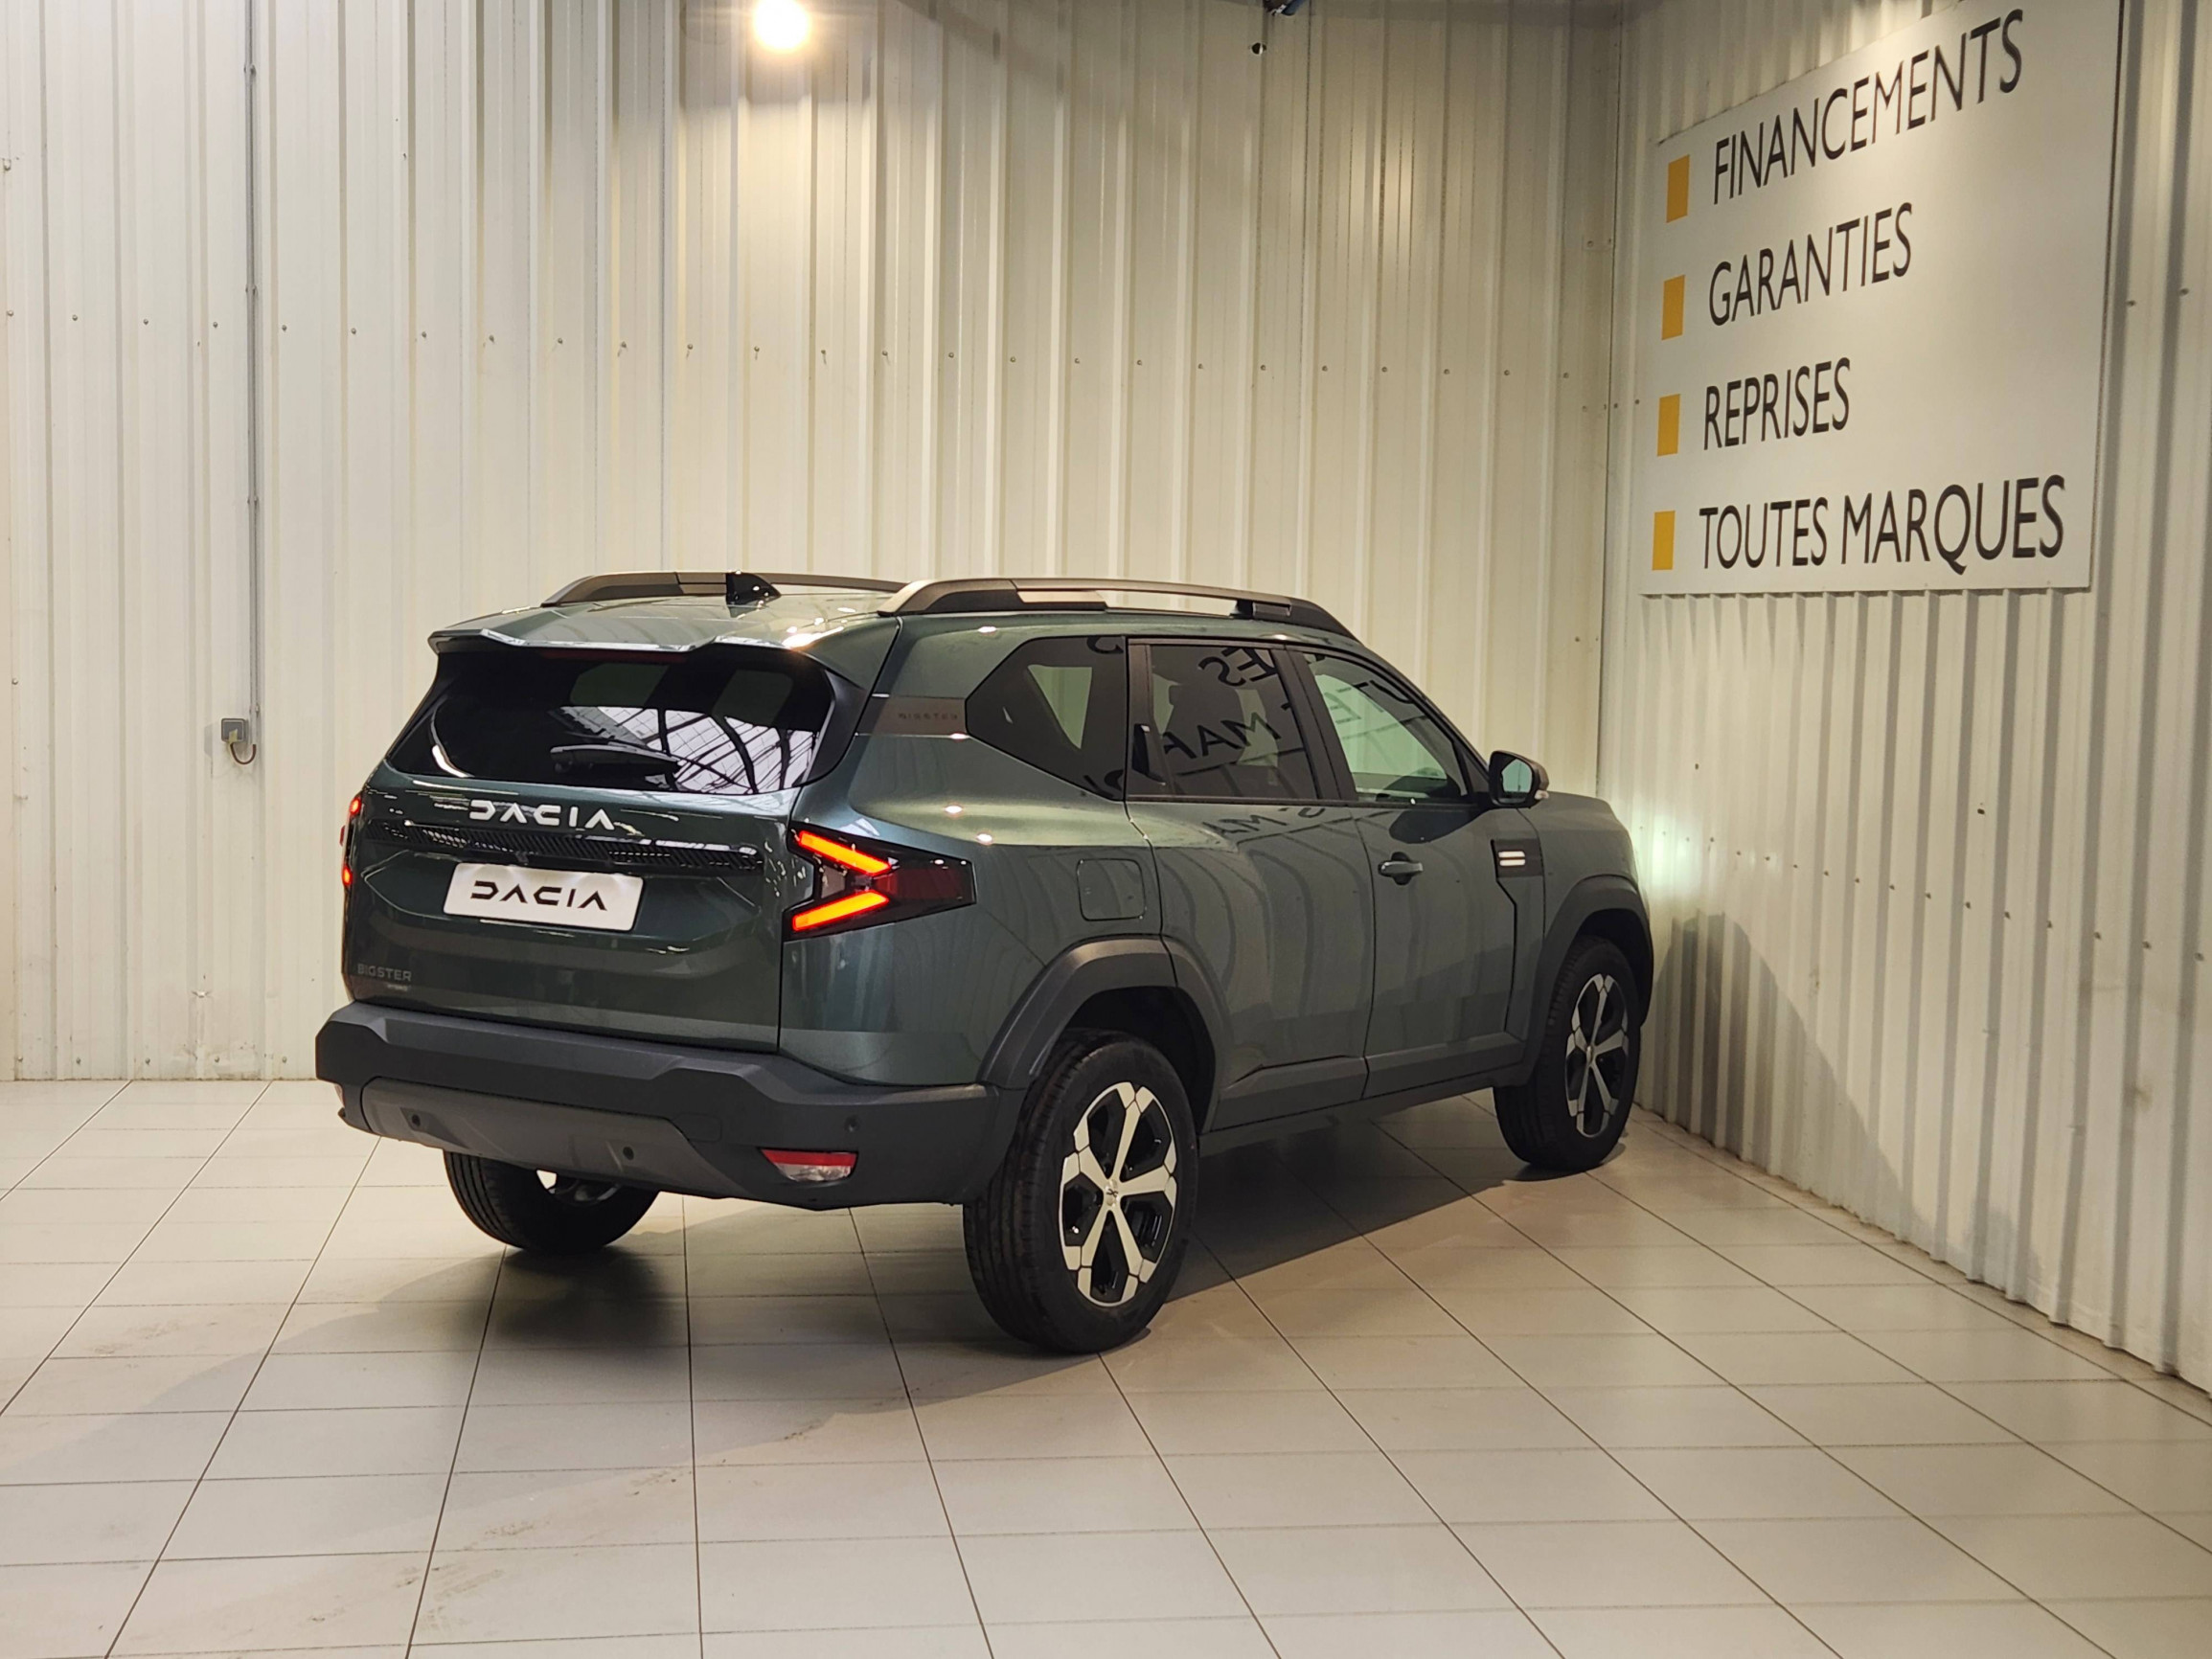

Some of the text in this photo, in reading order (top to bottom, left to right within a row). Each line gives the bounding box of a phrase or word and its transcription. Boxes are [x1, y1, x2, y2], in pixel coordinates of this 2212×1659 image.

[1714, 9, 2023, 205] FINANCEMENTS
[1709, 202, 1913, 327] GARANTIES
[1703, 357, 1851, 450] REPRISES
[1699, 474, 2065, 576] TOUTES MARQUES
[469, 799, 615, 830] DACIA
[469, 879, 608, 911] DACIA
[357, 964, 412, 981] BIGSTER
